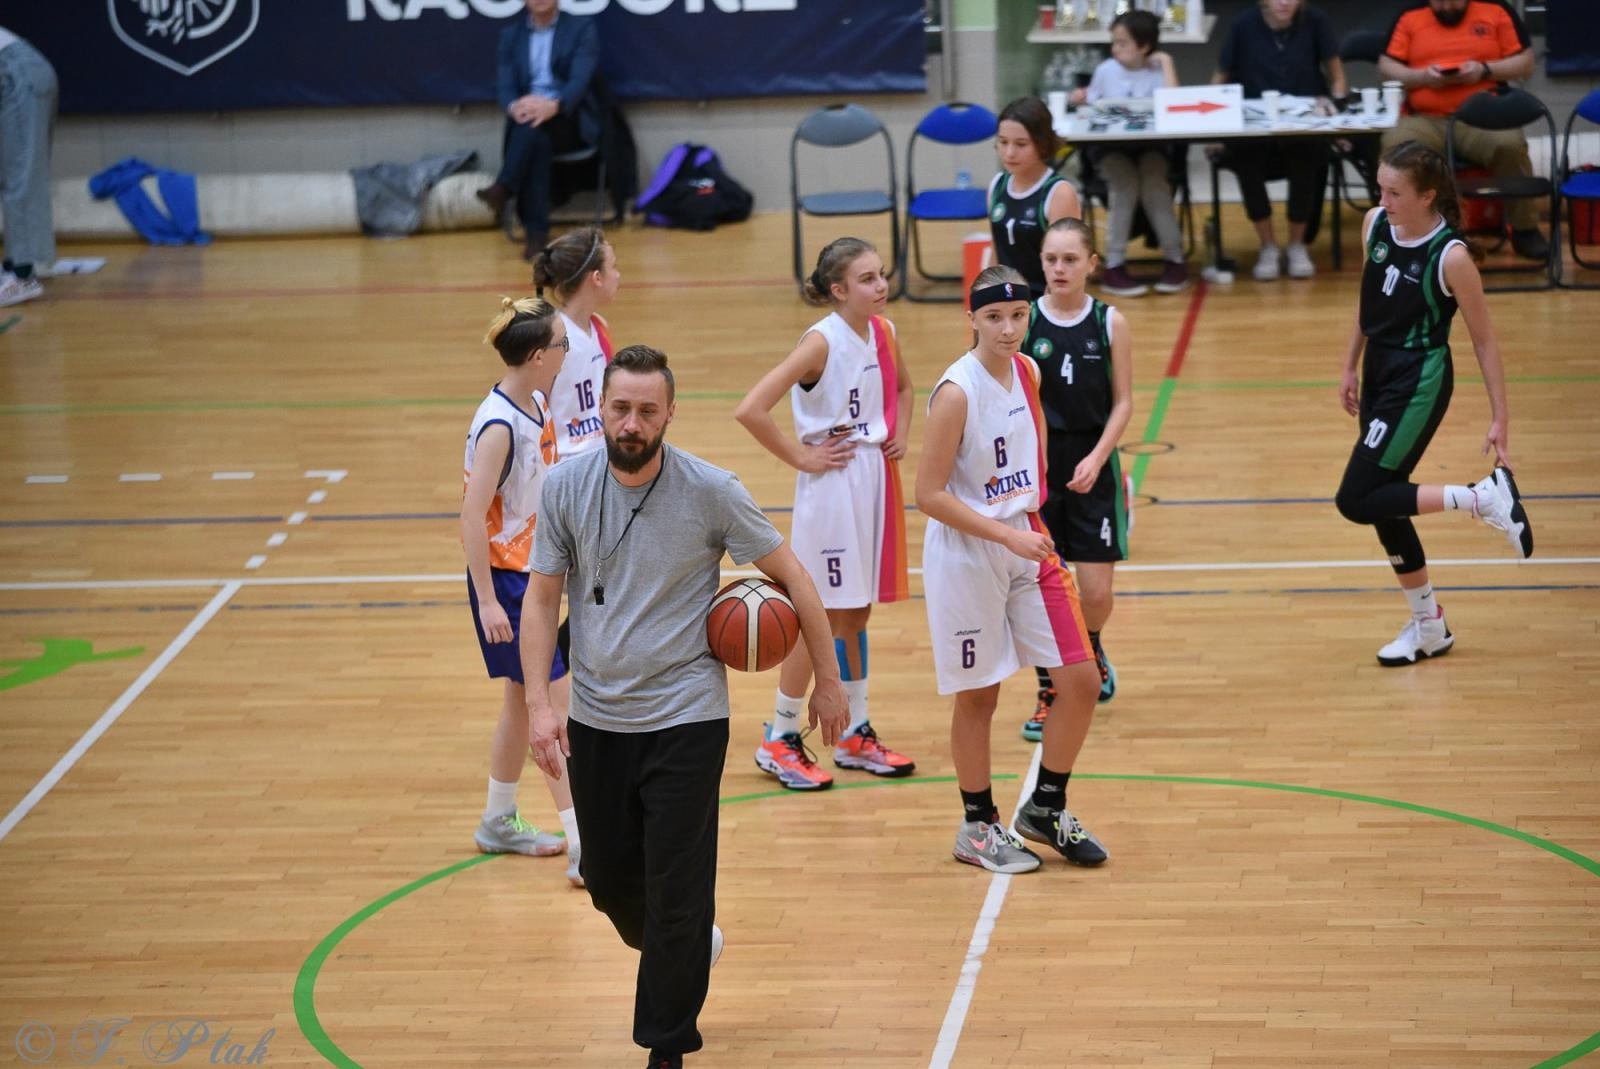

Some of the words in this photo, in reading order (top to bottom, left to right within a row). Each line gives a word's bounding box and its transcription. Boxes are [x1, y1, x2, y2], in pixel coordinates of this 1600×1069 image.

[1006, 218, 1016, 246] 1
[1381, 264, 1400, 296] 10
[1061, 353, 1073, 385] 4
[574, 378, 596, 412] 16
[848, 387, 860, 419] 5
[566, 416, 604, 437] MIN
[1364, 417, 1388, 449] 10
[993, 436, 1008, 469] 6
[984, 469, 1032, 499] MINI
[1100, 517, 1112, 547] 4
[827, 556, 842, 588] 5
[962, 638, 976, 669] 6
